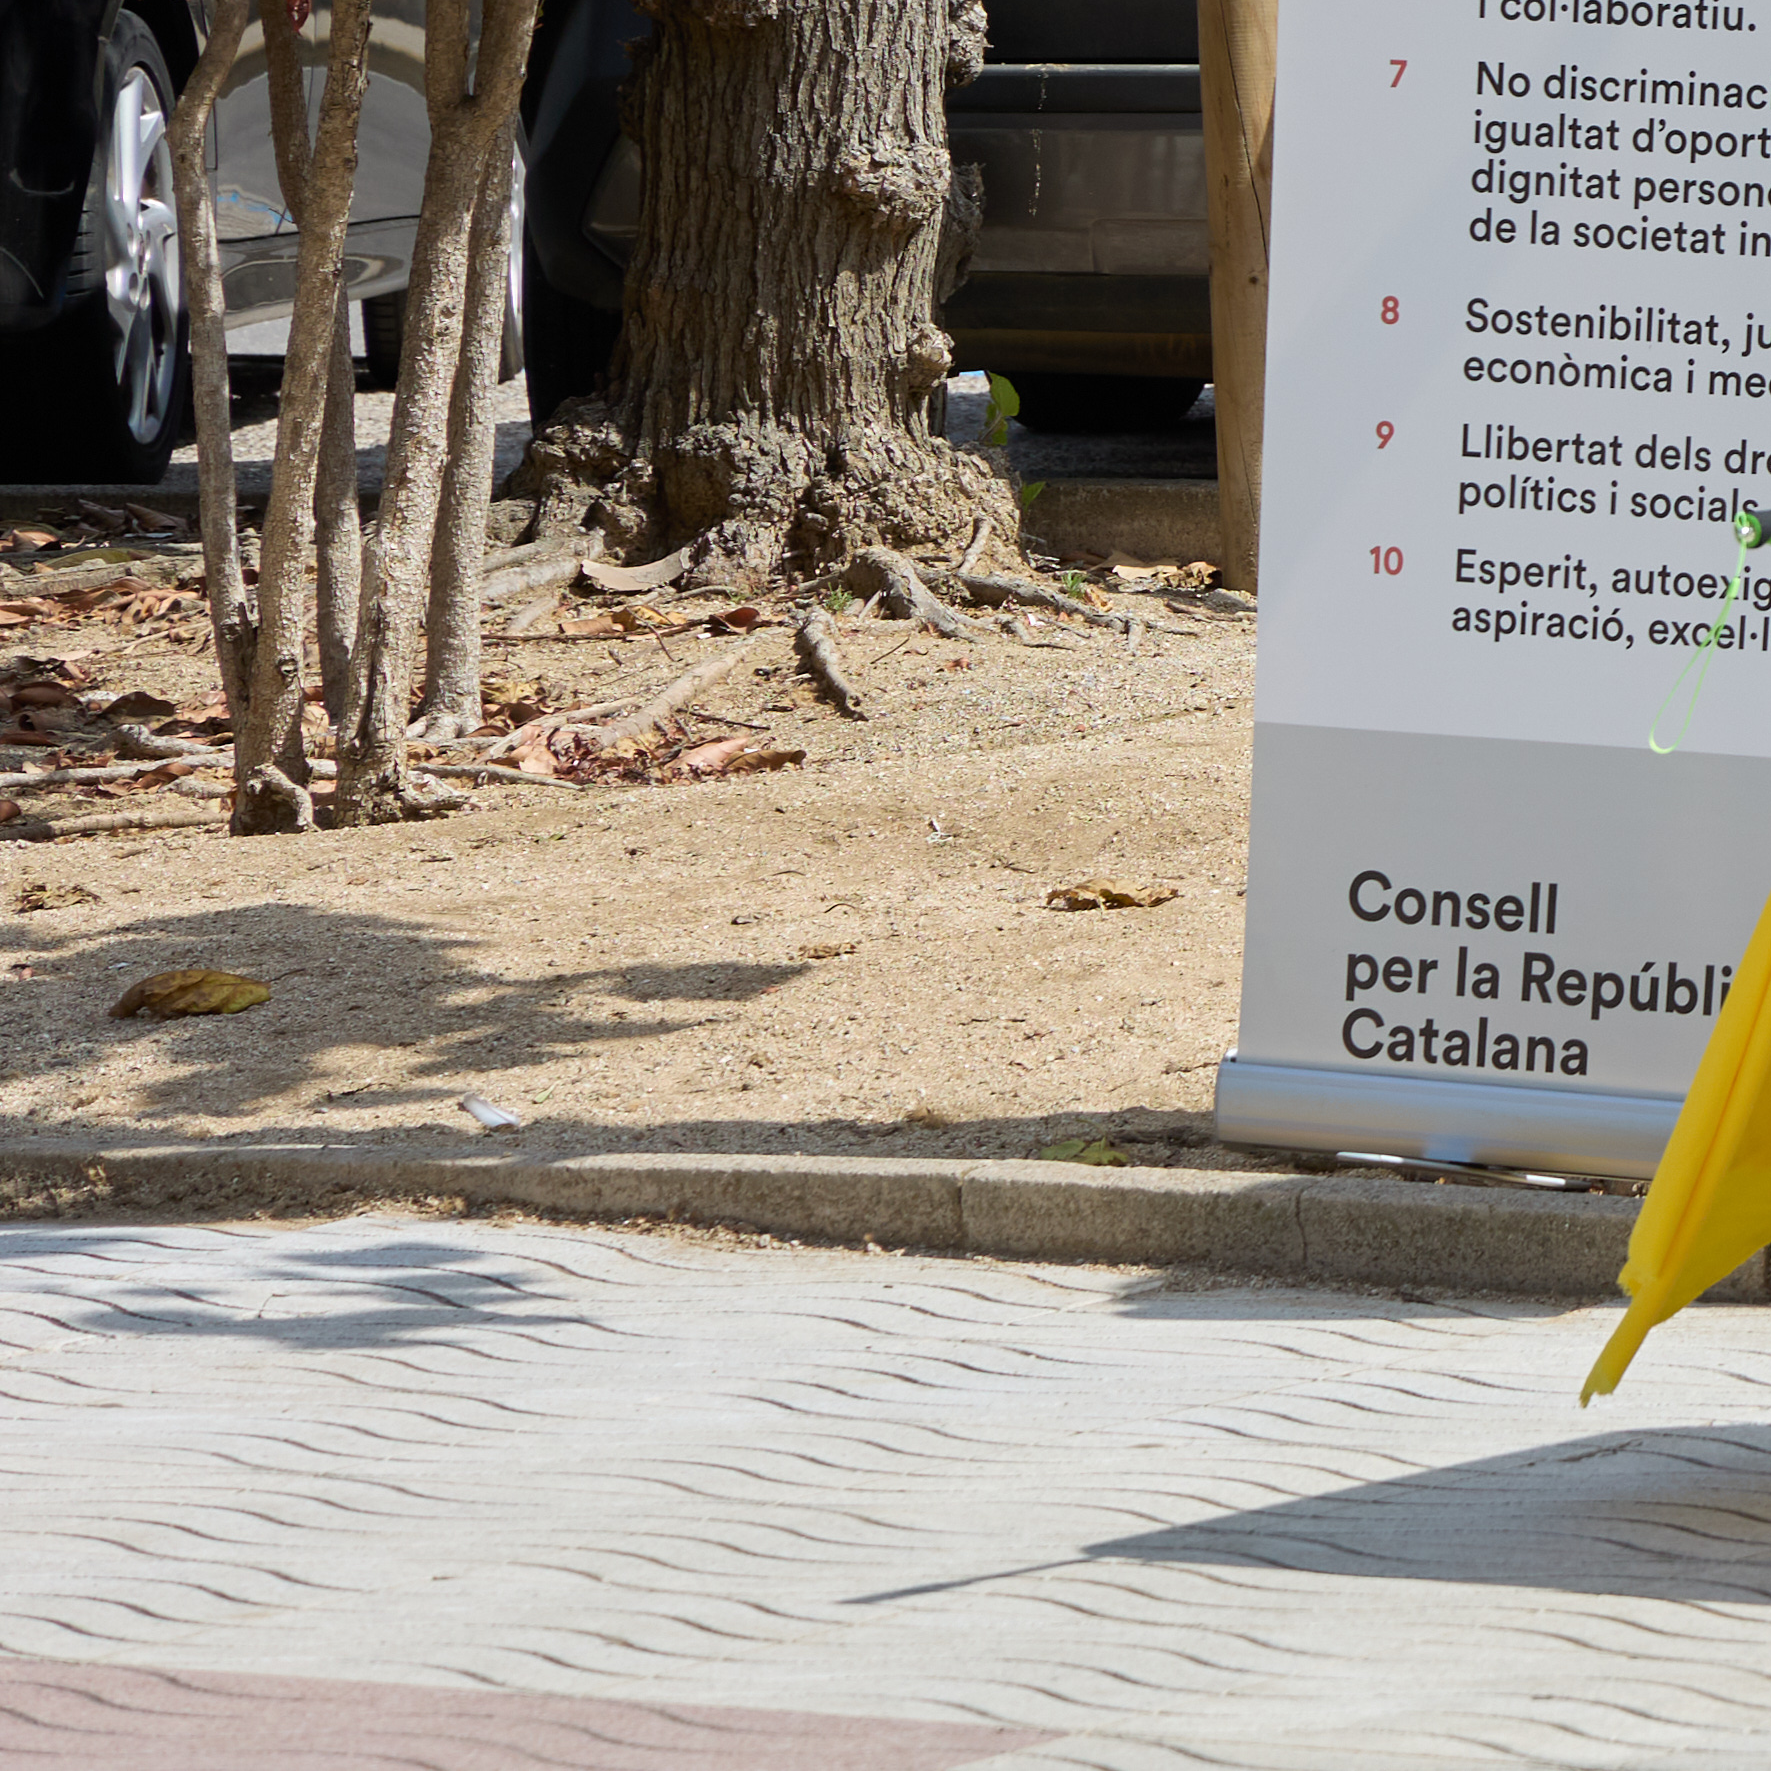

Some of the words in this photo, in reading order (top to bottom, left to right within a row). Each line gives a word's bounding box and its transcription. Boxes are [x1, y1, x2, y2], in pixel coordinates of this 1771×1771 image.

[1390, 59, 1407, 88] 7
[1476, 61, 1531, 98] No
[1474, 113, 1620, 154] igualtat
[1471, 158, 1621, 205] dignitat
[1469, 207, 1517, 244] de
[1530, 209, 1560, 246] la
[1573, 215, 1726, 255] societat
[1381, 296, 1399, 325] 8
[1465, 297, 1730, 354] Sostenibilitat,
[1463, 352, 1672, 393] econòmica
[1686, 358, 1695, 394] i
[1376, 421, 1395, 449] 9
[1461, 423, 1623, 467] Llibertat
[1635, 433, 1711, 473] dels
[1458, 474, 1596, 515] polítics
[1610, 479, 1617, 515] i
[1369, 546, 1404, 576] 10
[1455, 548, 1597, 598] Esperit,
[1452, 600, 1634, 650] aspiració,
[1348, 869, 1558, 935] Consell
[1345, 953, 1439, 1002] per
[1455, 945, 1500, 1000] la
[1520, 951, 1733, 1021] Repúbli
[1341, 1007, 1589, 1077] Catalana
